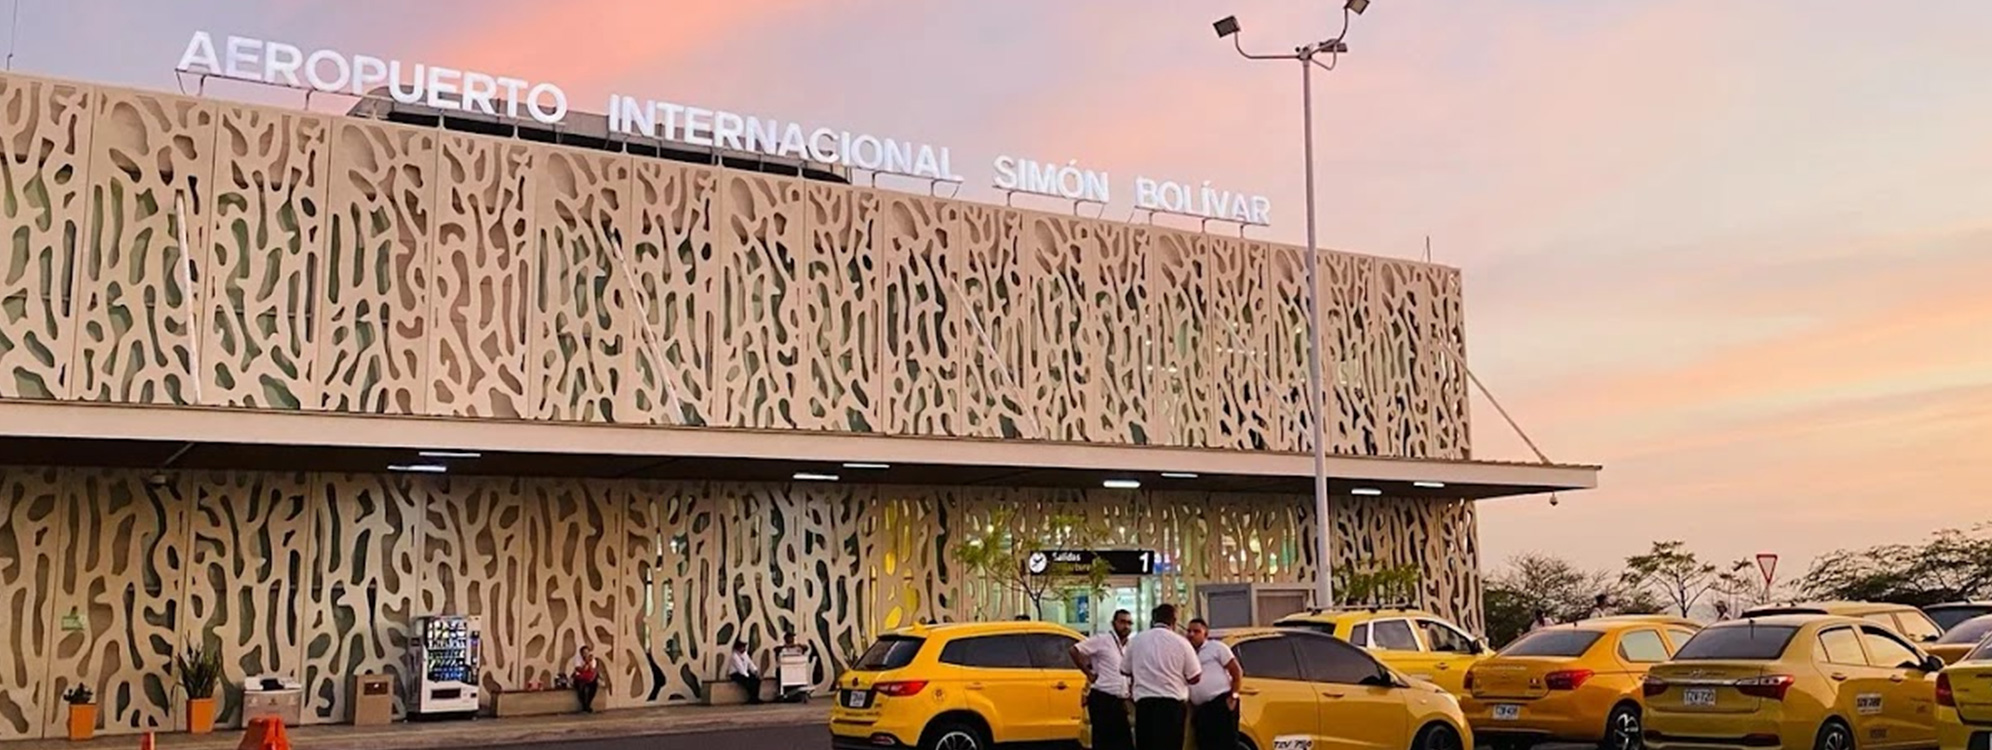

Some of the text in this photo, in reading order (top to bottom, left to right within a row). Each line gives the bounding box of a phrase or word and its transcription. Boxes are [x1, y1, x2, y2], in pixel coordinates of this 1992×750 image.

[177, 30, 1272, 225] AEROPUERTO INTERNACIONAL SIMÓN BOLÍVAR
[1139, 552, 1149, 573] 1
